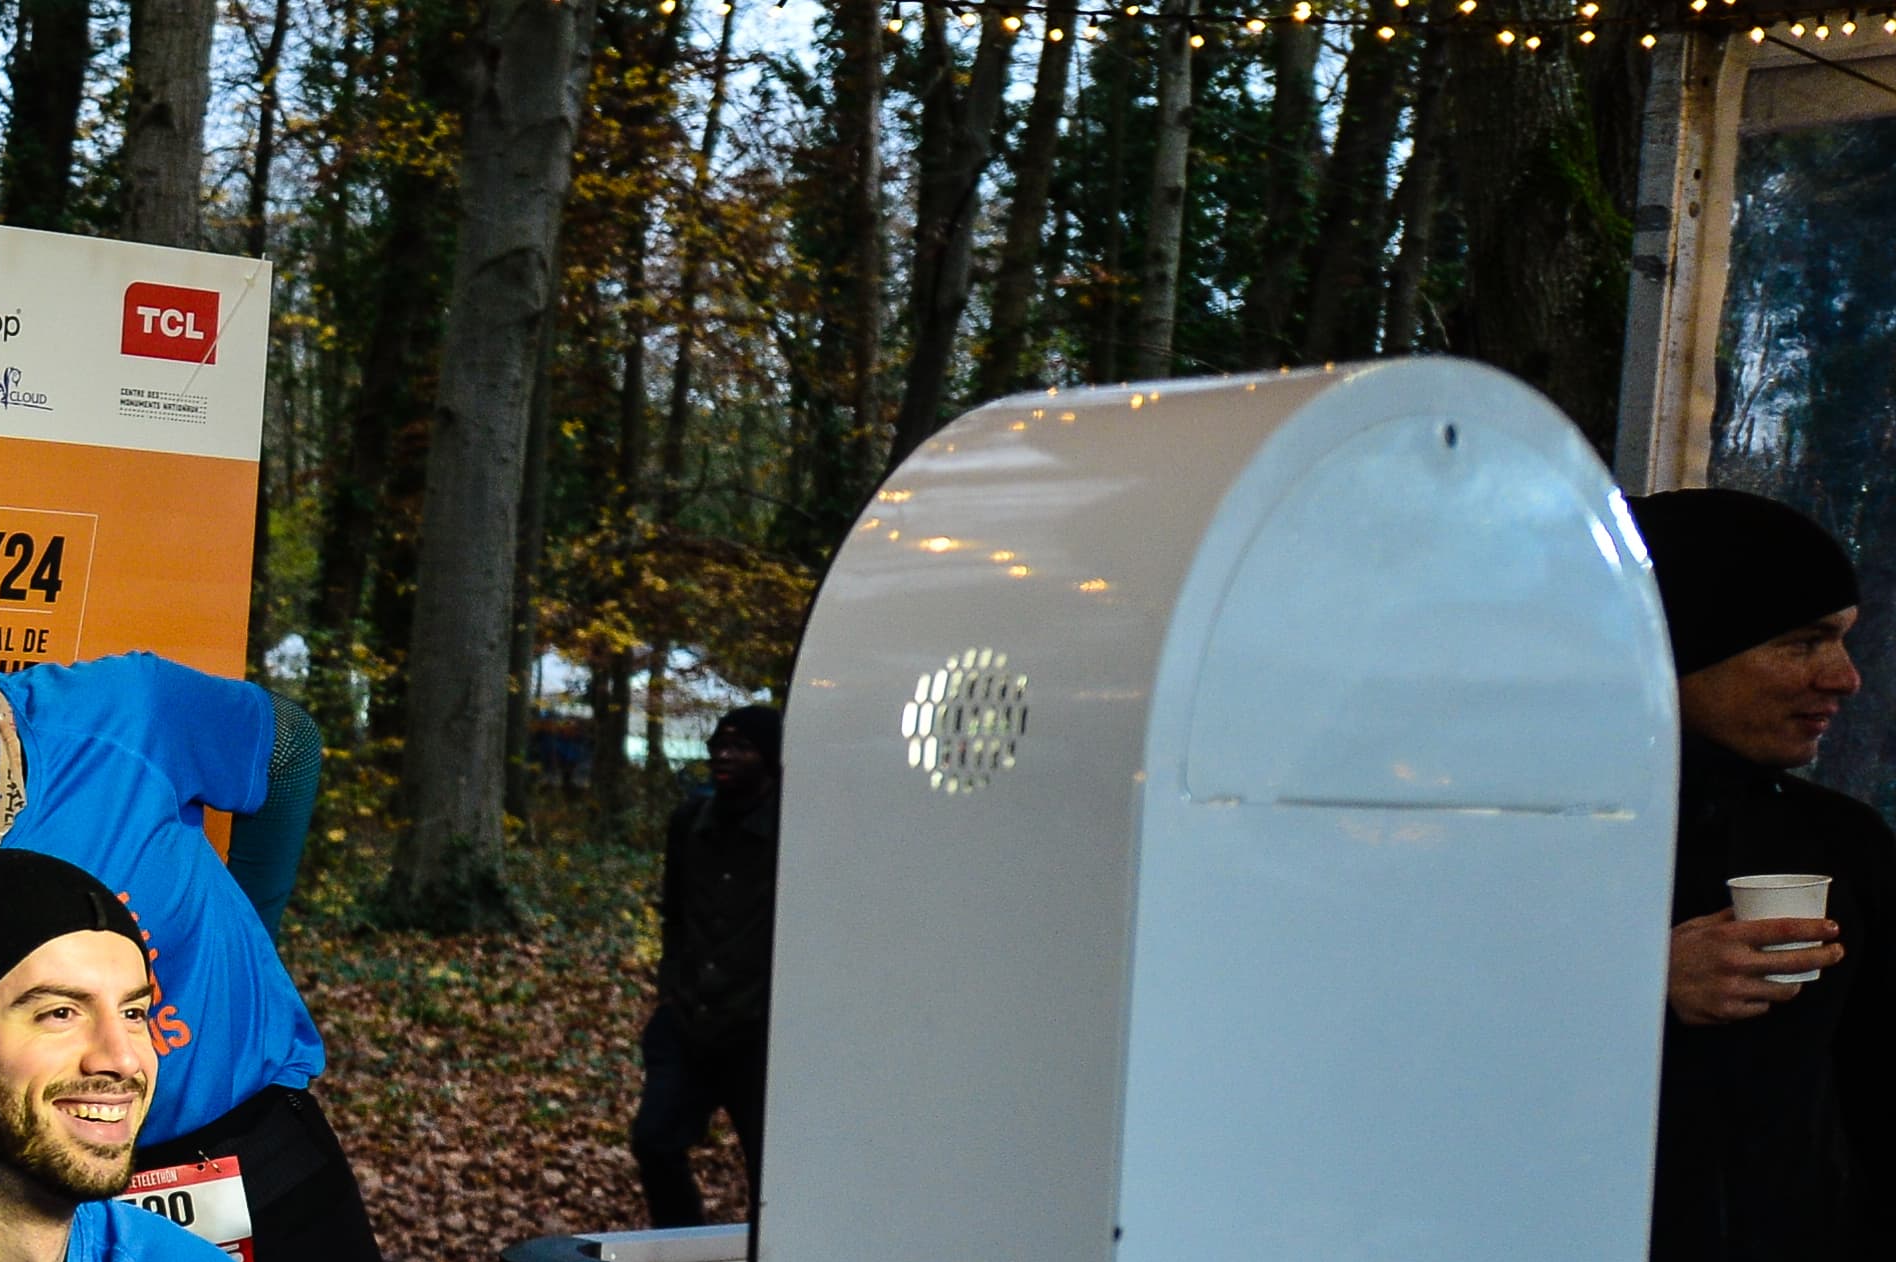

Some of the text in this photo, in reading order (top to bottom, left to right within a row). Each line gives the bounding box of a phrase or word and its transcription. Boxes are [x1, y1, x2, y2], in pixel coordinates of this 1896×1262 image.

[136, 306, 204, 340] TCL
[9, 391, 48, 404] CLOUD
[23, 628, 50, 653] DE
